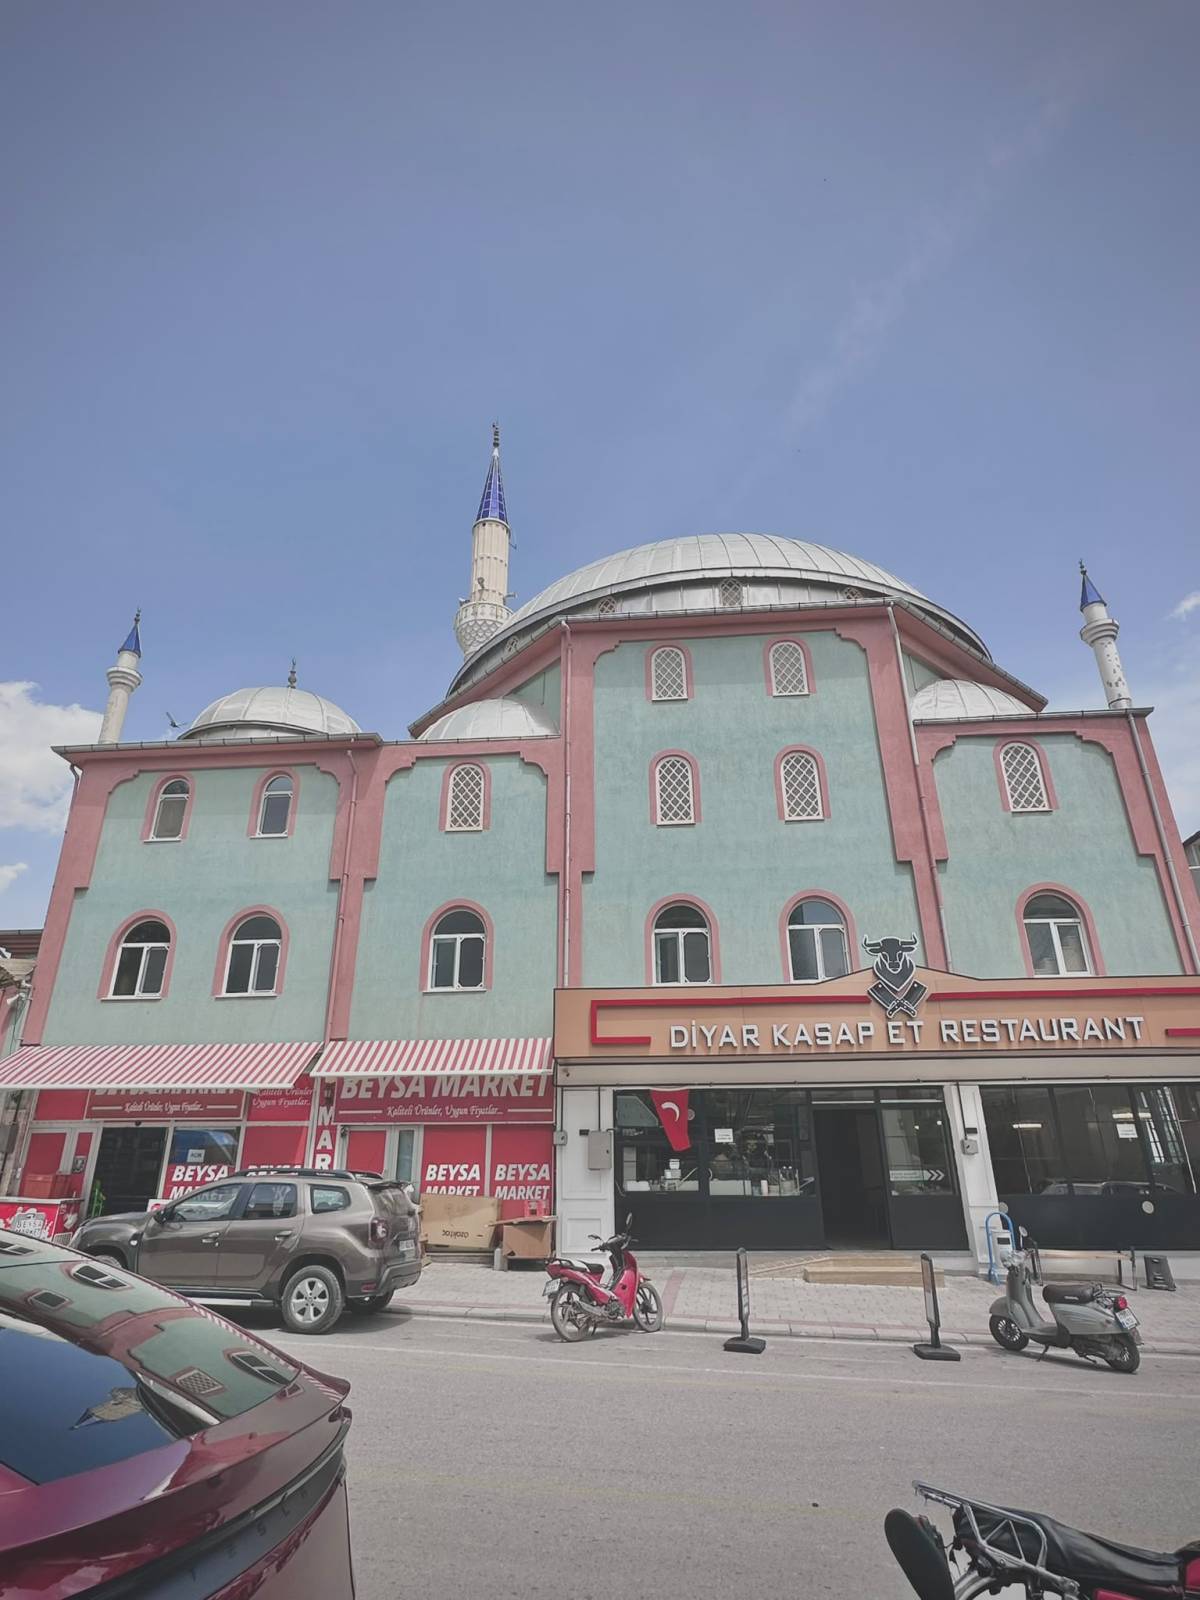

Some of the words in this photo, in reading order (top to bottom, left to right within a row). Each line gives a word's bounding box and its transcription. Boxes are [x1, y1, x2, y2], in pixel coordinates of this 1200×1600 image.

[669, 1019, 760, 1049] DİYAR
[772, 1021, 876, 1047] KASAP
[887, 1020, 924, 1045] ET
[940, 1016, 1145, 1044] RESTAURANT
[340, 1074, 426, 1099] BEYSA
[431, 1074, 547, 1099] MARKET
[171, 1164, 230, 1182] BEYSA
[424, 1164, 481, 1181] BEYSA
[494, 1164, 551, 1181] BEYSA
[494, 1185, 550, 1200] MARKET
